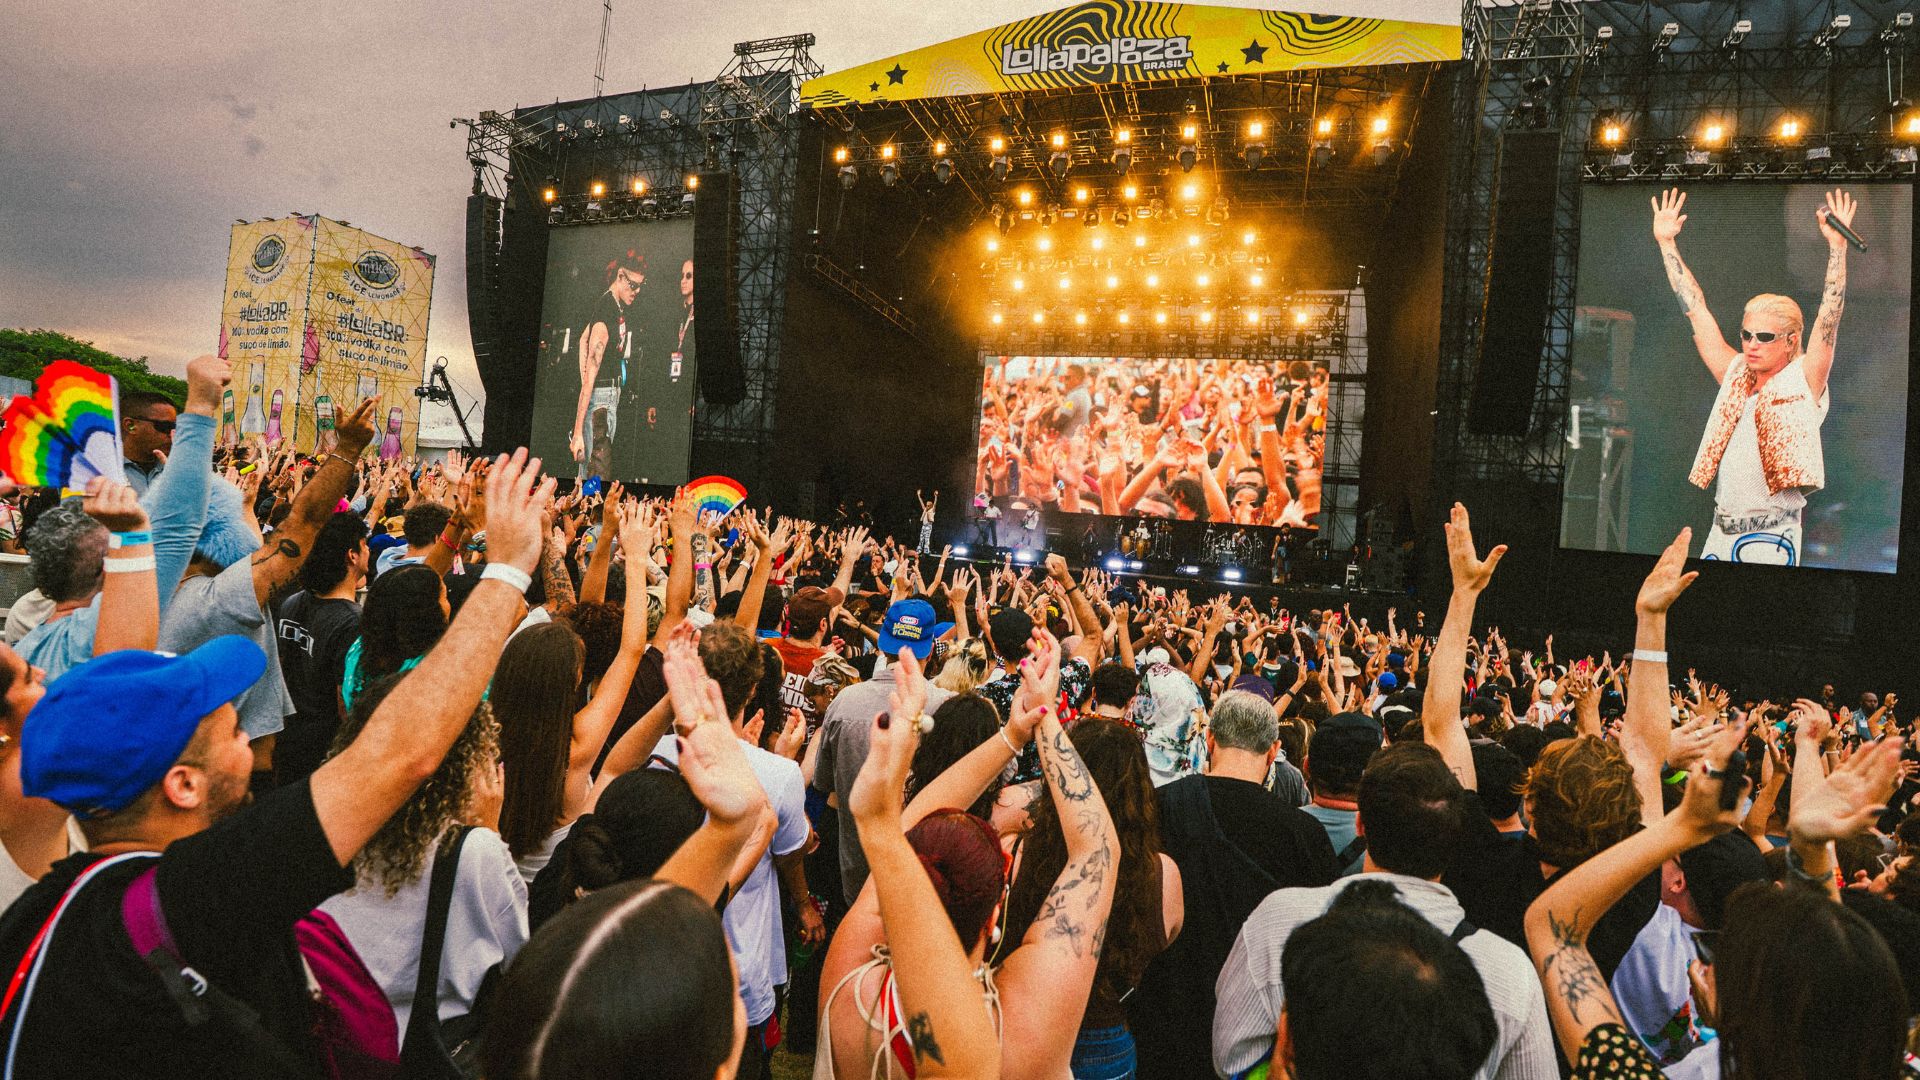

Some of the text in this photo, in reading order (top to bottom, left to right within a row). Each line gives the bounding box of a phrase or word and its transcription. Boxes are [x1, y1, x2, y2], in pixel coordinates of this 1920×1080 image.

[1002, 37, 1193, 75] Lollapalooza
[1143, 60, 1184, 70] BRASIL
[350, 280, 401, 300] ICE LEMONADE
[327, 291, 335, 300] O
[336, 293, 356, 306] feat
[247, 325, 269, 336] vodka
[271, 326, 289, 335] com
[239, 341, 258, 350] suco
[350, 338, 382, 351] vodka
[384, 345, 407, 357] com
[338, 349, 366, 361] suco
